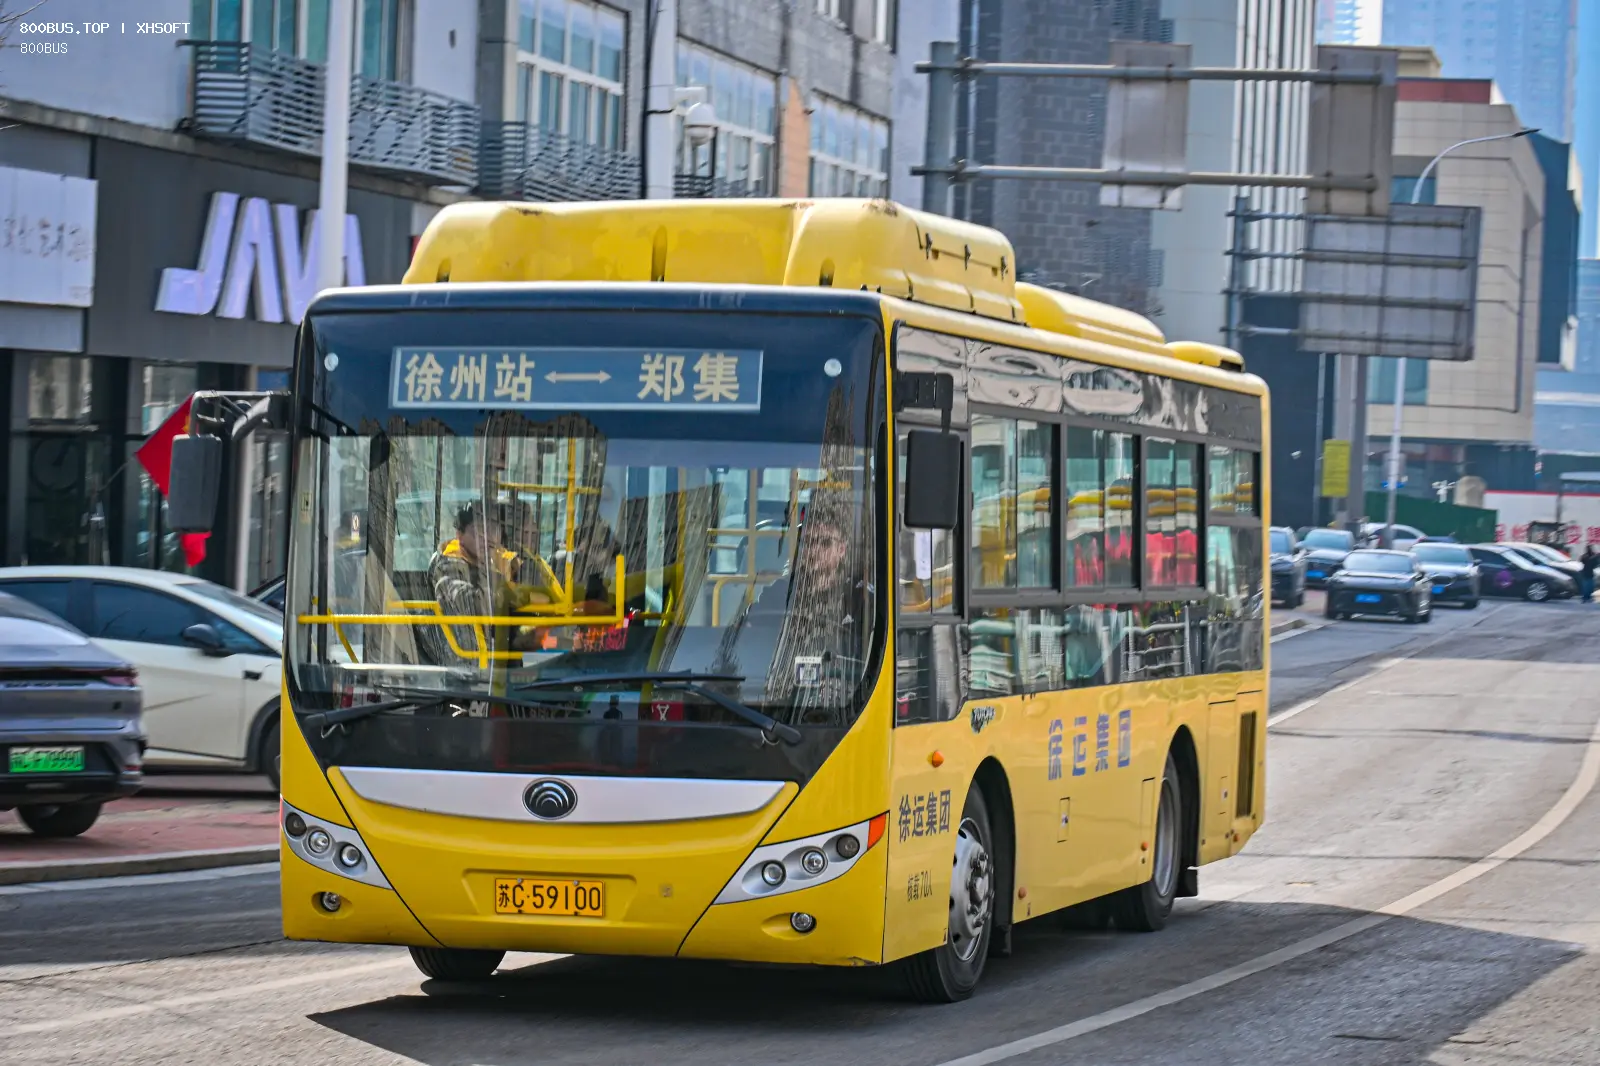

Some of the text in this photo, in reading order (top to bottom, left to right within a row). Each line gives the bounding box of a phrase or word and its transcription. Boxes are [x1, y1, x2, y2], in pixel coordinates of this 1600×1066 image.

[404, 353, 741, 402] 徐州站 郑集
[898, 789, 951, 842] 徐运集团
